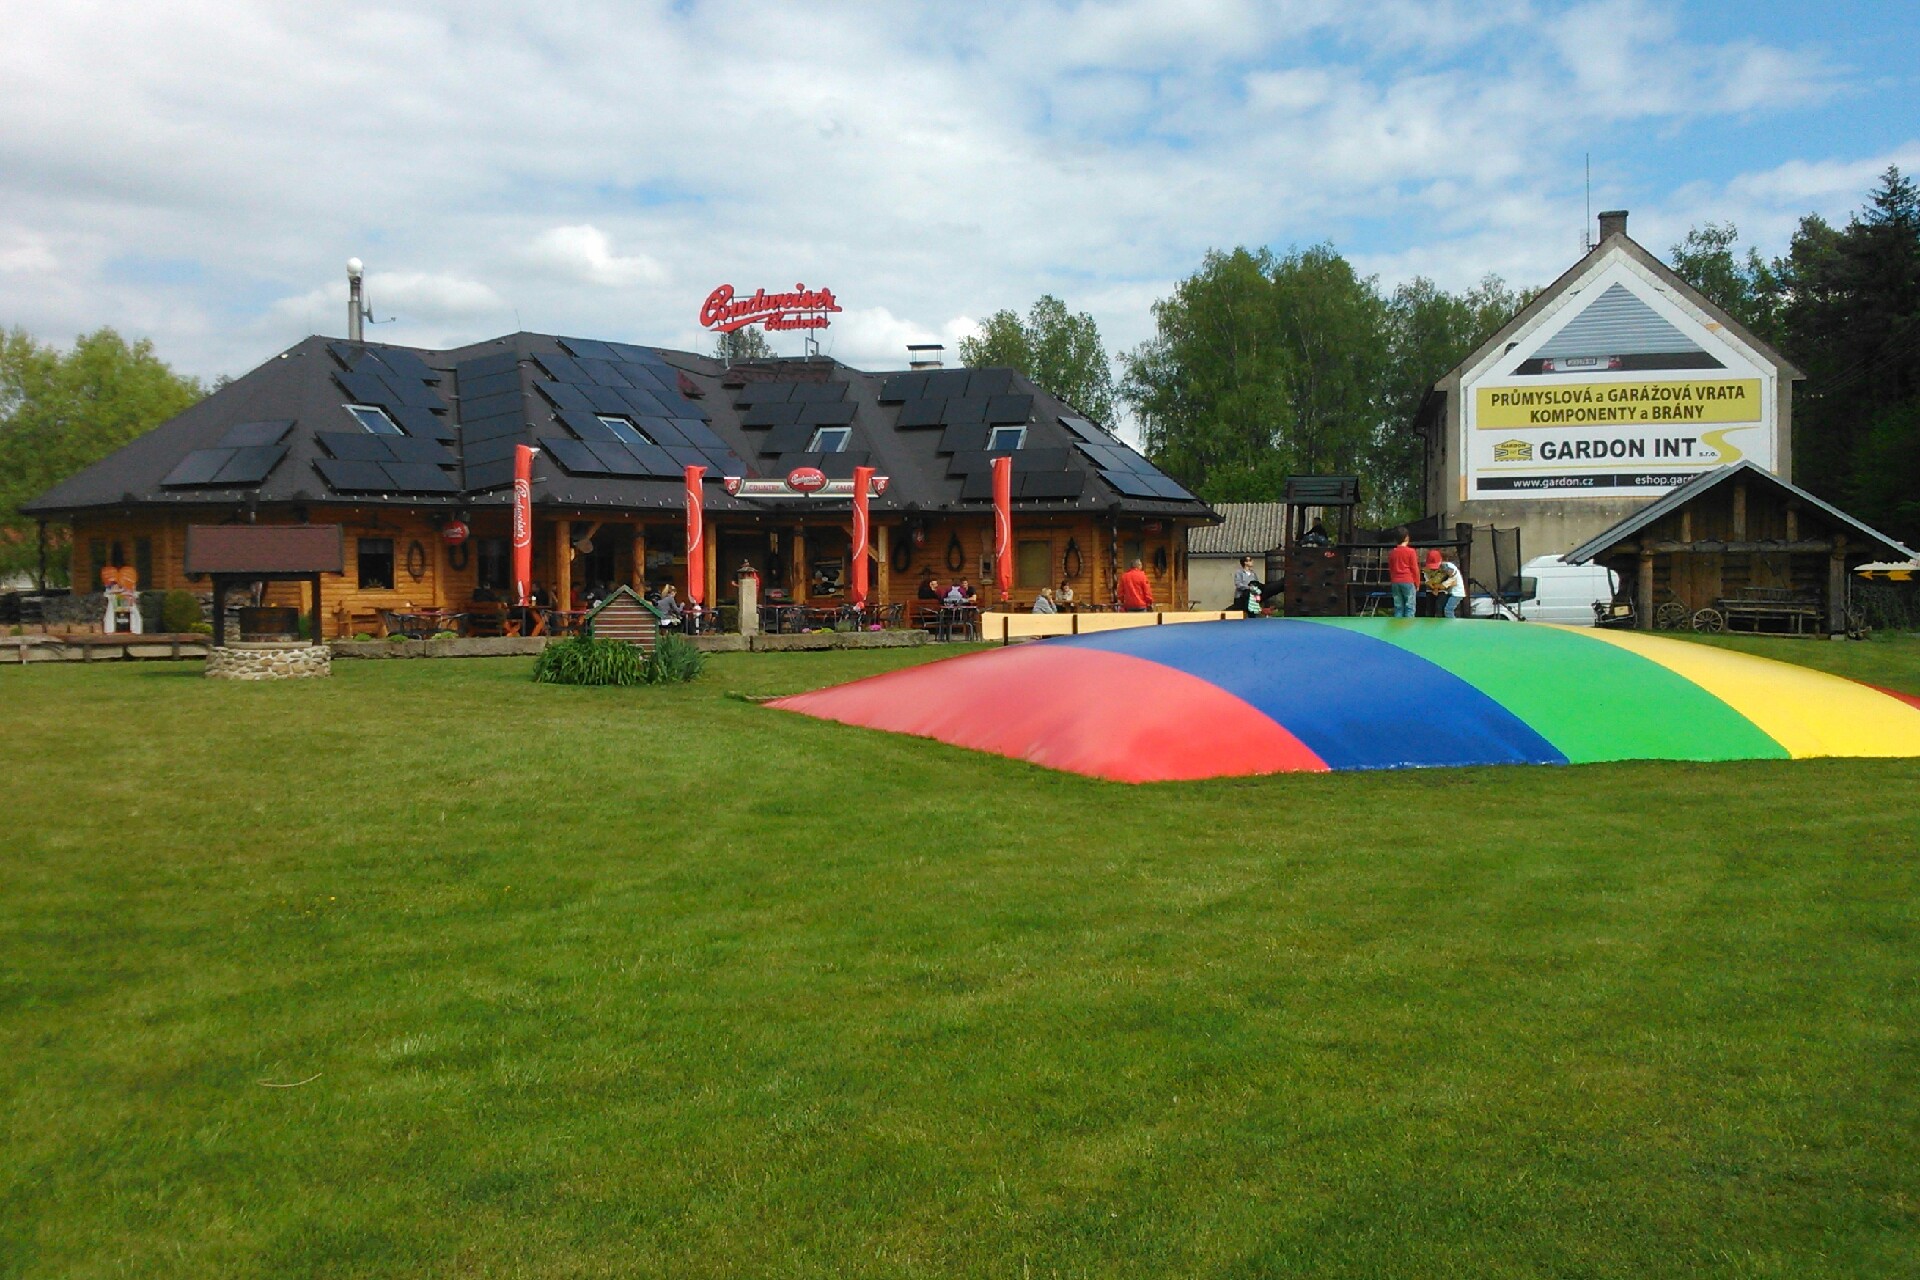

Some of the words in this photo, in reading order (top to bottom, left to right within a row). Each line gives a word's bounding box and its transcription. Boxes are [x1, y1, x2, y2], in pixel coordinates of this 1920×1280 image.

[700, 283, 842, 331] Budweiser
[1491, 387, 1592, 406] PRŮMYSLOVÁ
[1596, 392, 1603, 402] a
[1607, 384, 1692, 402] GARÁŽOVÁ
[1696, 386, 1745, 400] VRATA
[1530, 407, 1637, 423] KOMPONENTY
[1640, 409, 1648, 420] a
[1652, 403, 1704, 420] BRÁNY
[1539, 438, 1645, 461] GARDON
[1654, 438, 1696, 458] INT
[1513, 477, 1594, 489] www.gardon.cz
